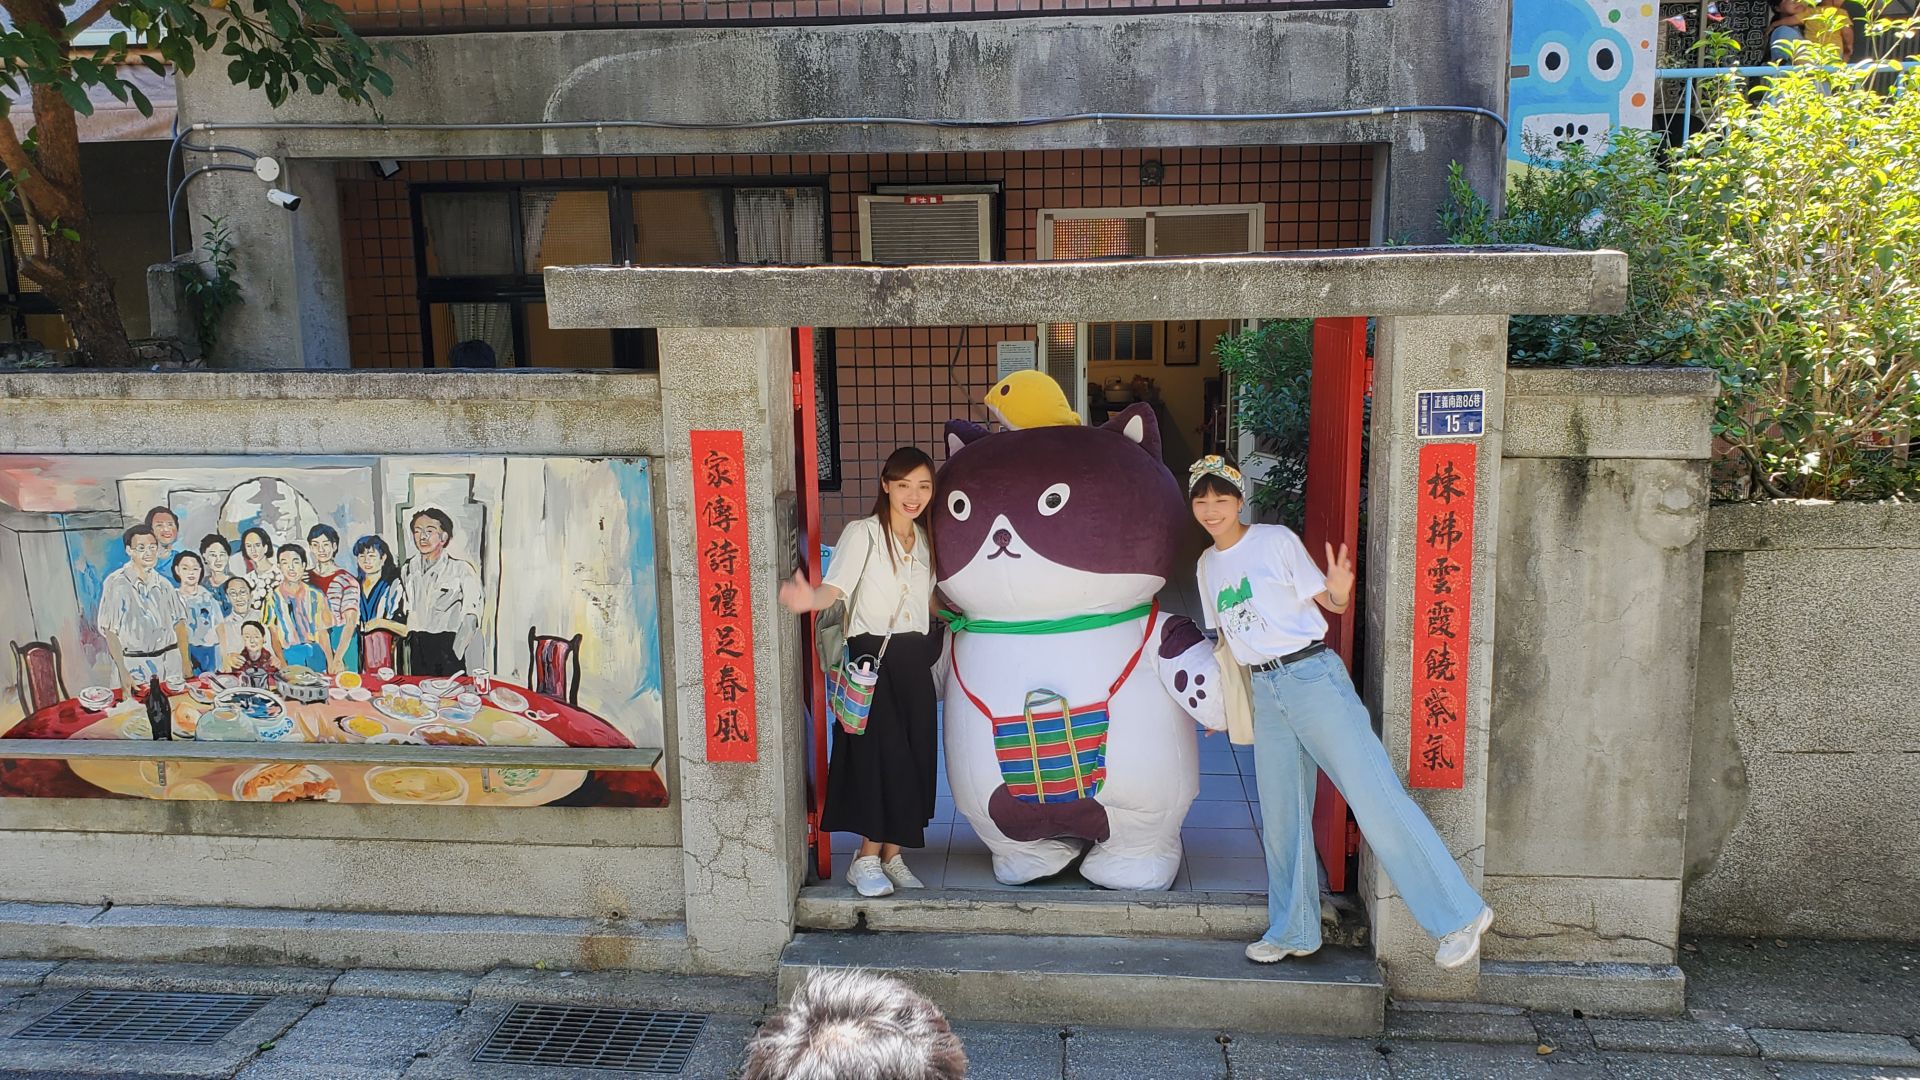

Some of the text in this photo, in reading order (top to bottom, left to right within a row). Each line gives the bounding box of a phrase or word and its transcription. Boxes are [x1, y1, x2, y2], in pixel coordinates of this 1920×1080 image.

[1434, 394, 1481, 409] 正義南路86巷
[1445, 414, 1460, 433] 15
[702, 450, 749, 743] 家傳詩禮足春風
